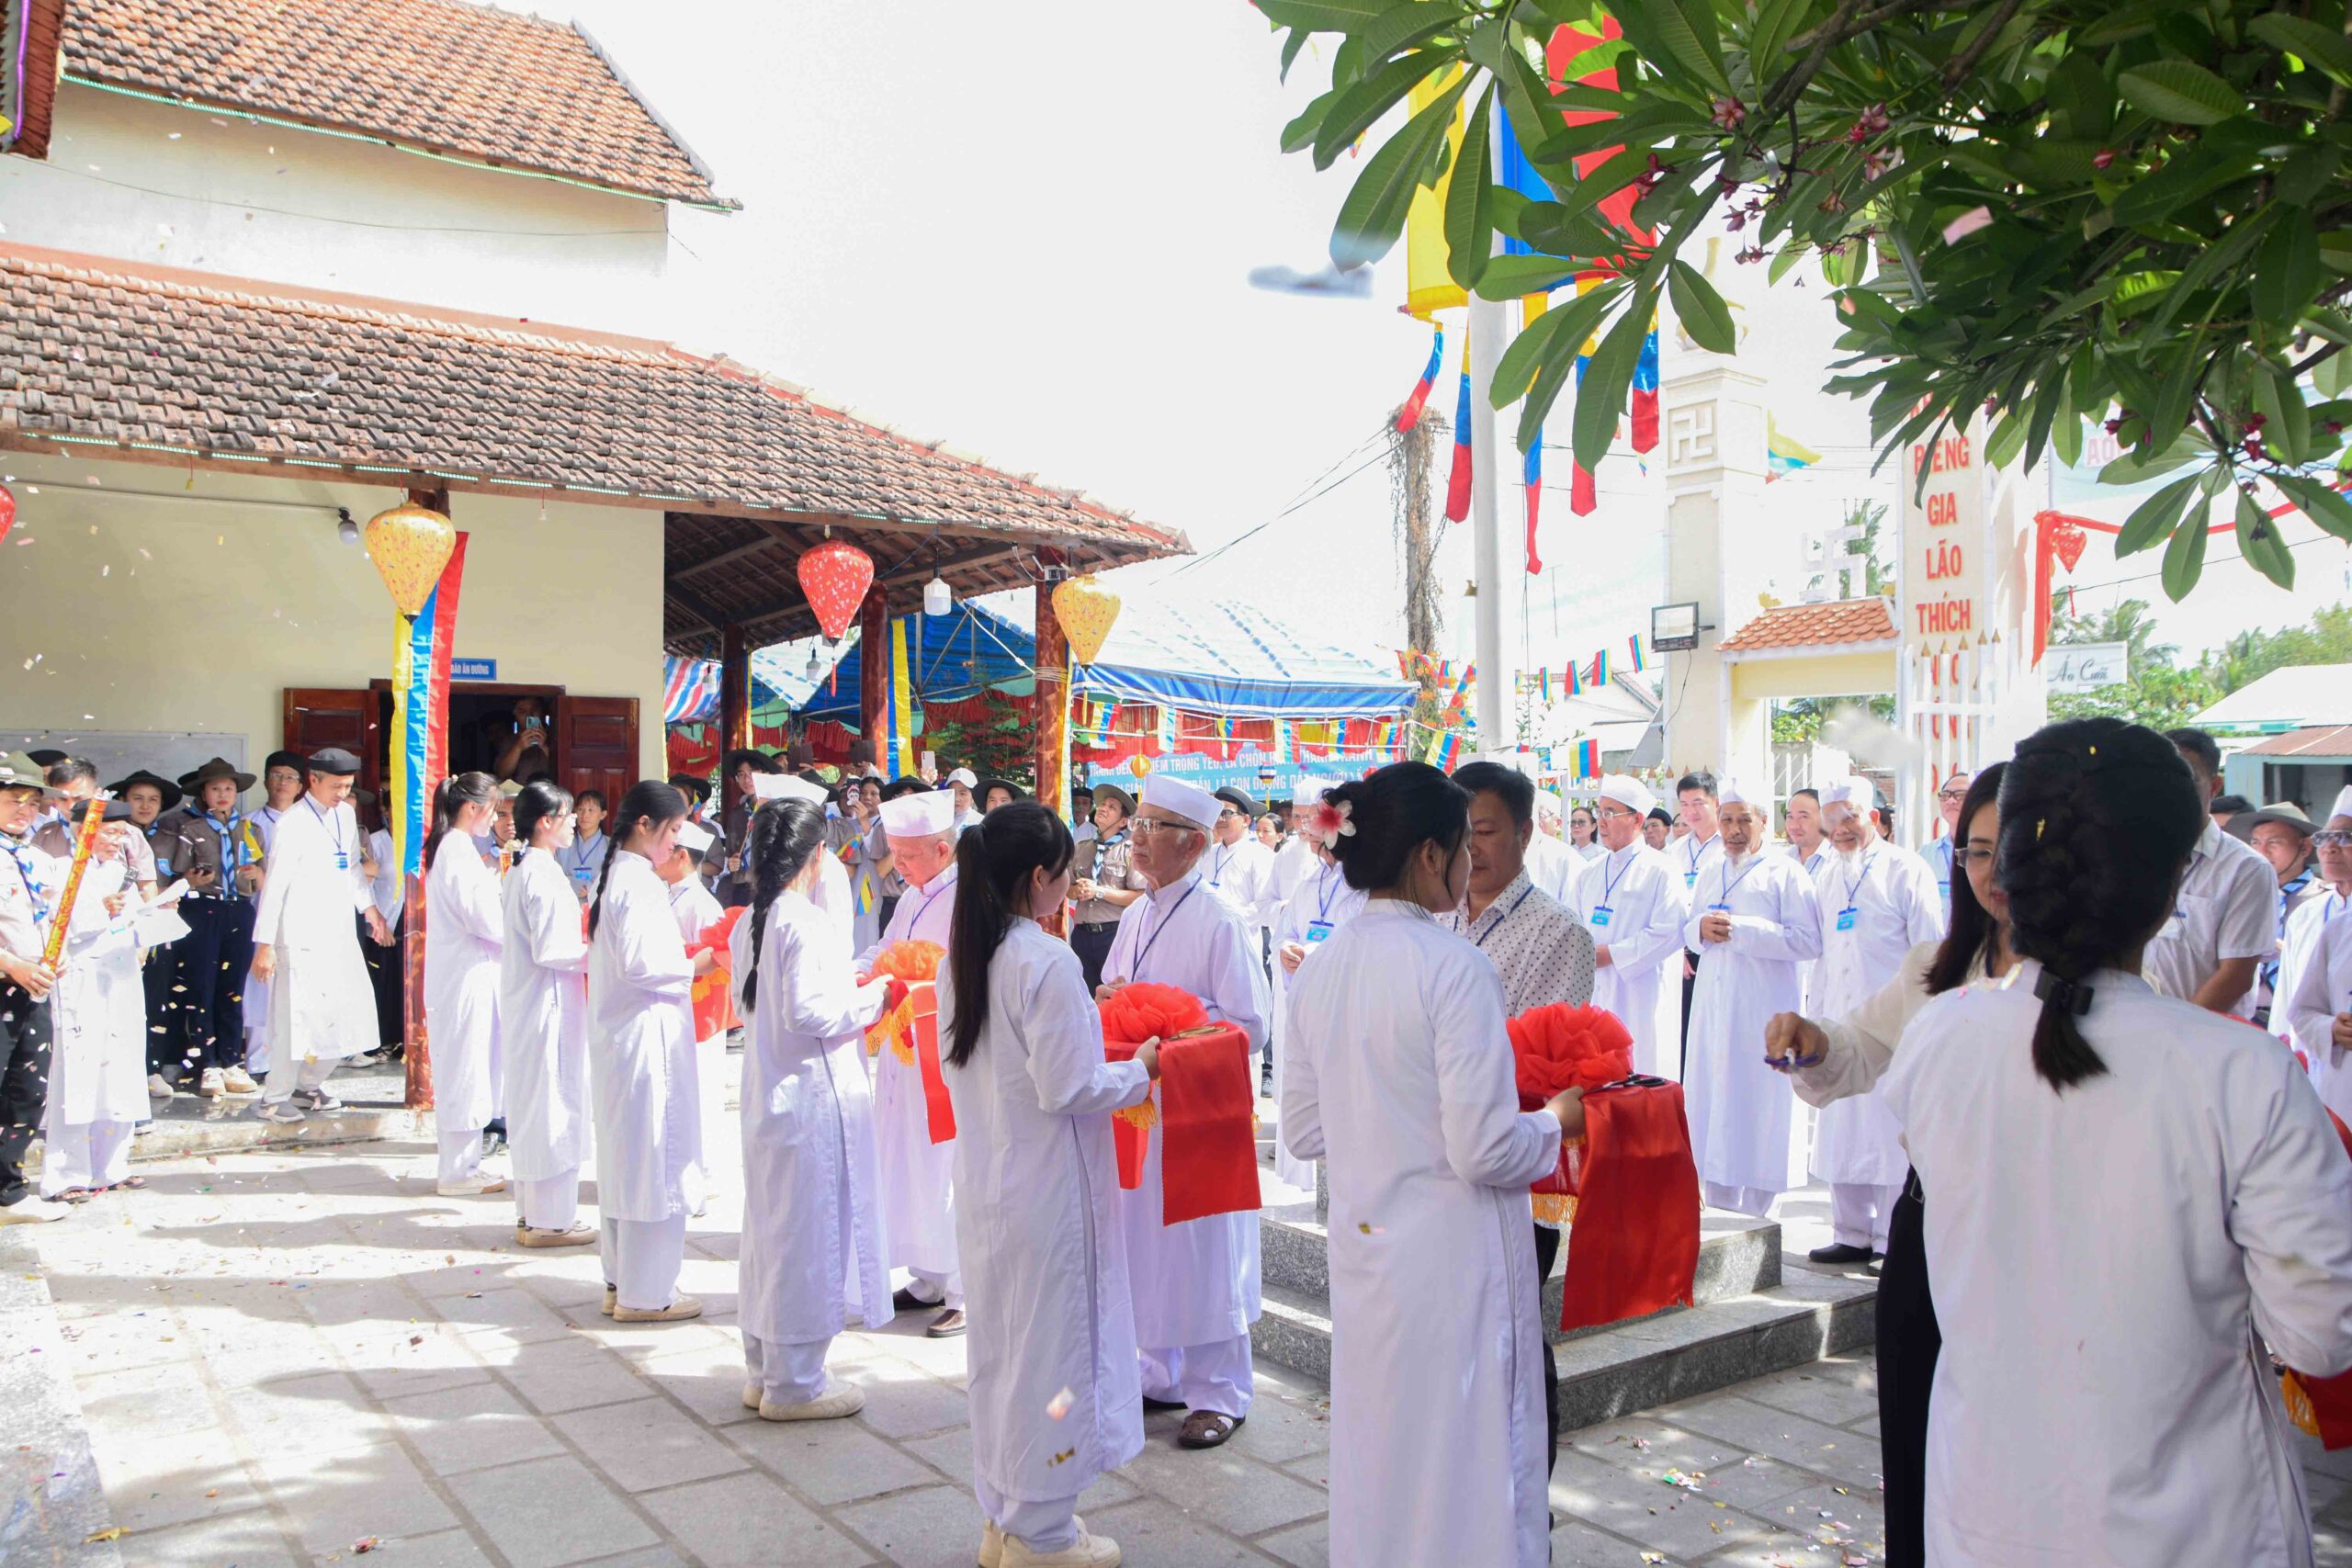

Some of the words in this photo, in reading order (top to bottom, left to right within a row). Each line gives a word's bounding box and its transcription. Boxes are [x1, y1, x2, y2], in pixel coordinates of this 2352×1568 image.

[1927, 491, 1957, 526] GIA
[1926, 538, 1962, 580] LÃO
[1916, 592, 1971, 634] THÍCH
